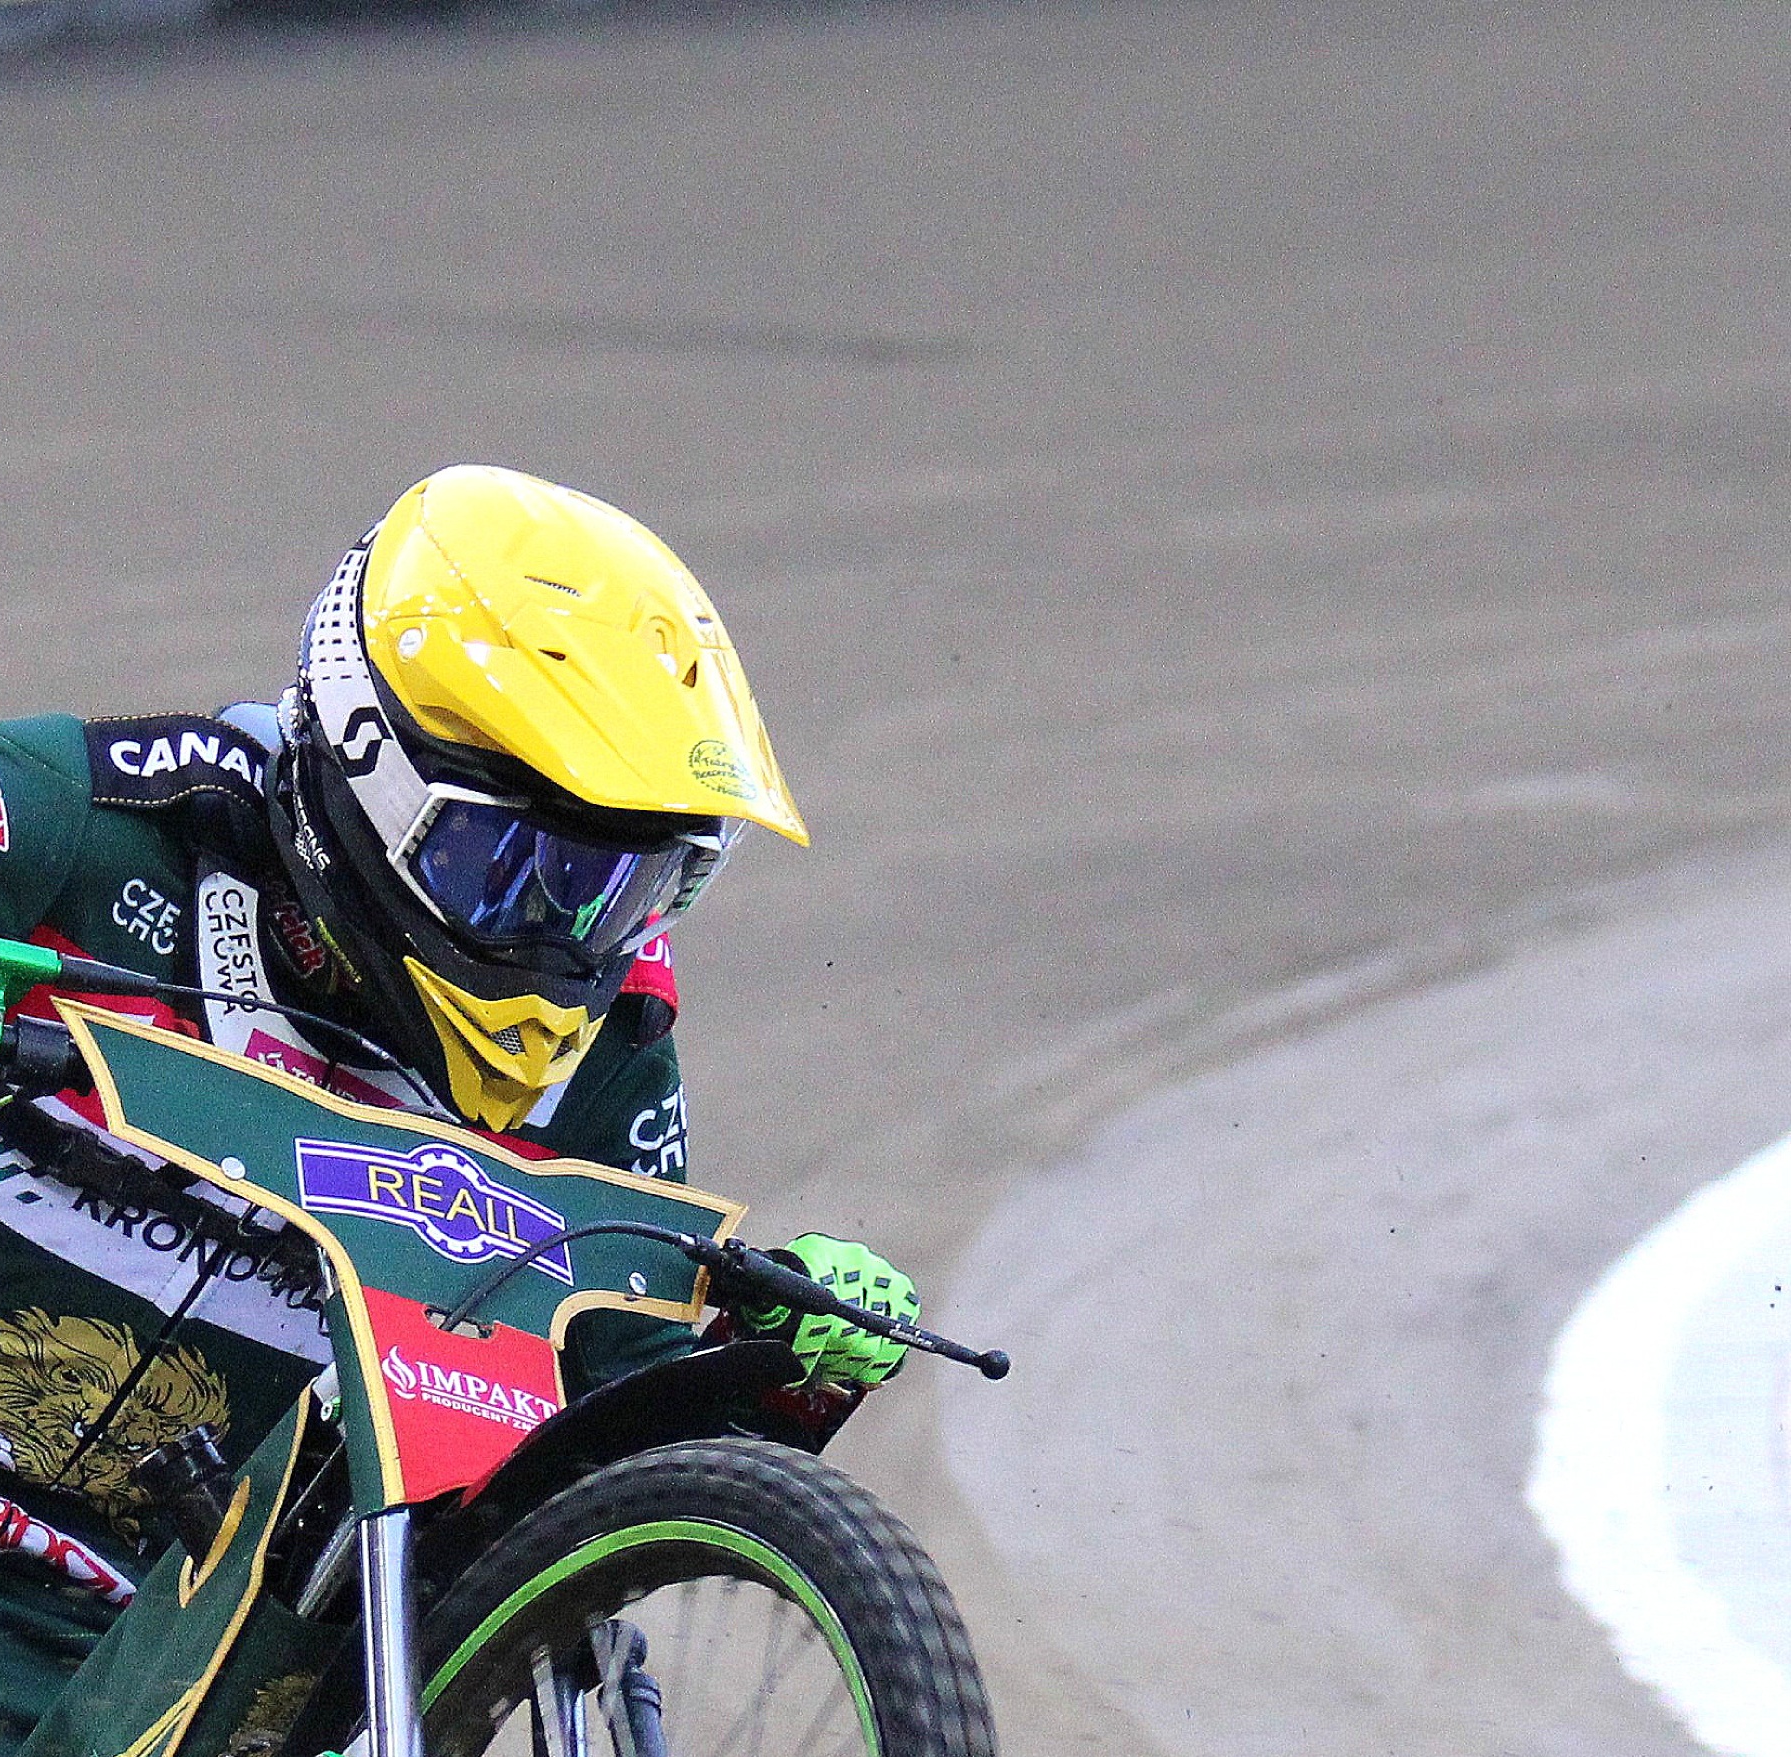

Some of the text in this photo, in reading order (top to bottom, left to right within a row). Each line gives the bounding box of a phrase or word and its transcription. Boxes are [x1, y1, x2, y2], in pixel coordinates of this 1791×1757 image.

[367, 1163, 532, 1248] REALL
[414, 1360, 558, 1420] IMPAKT
[421, 1392, 510, 1426] PRODUCENT
